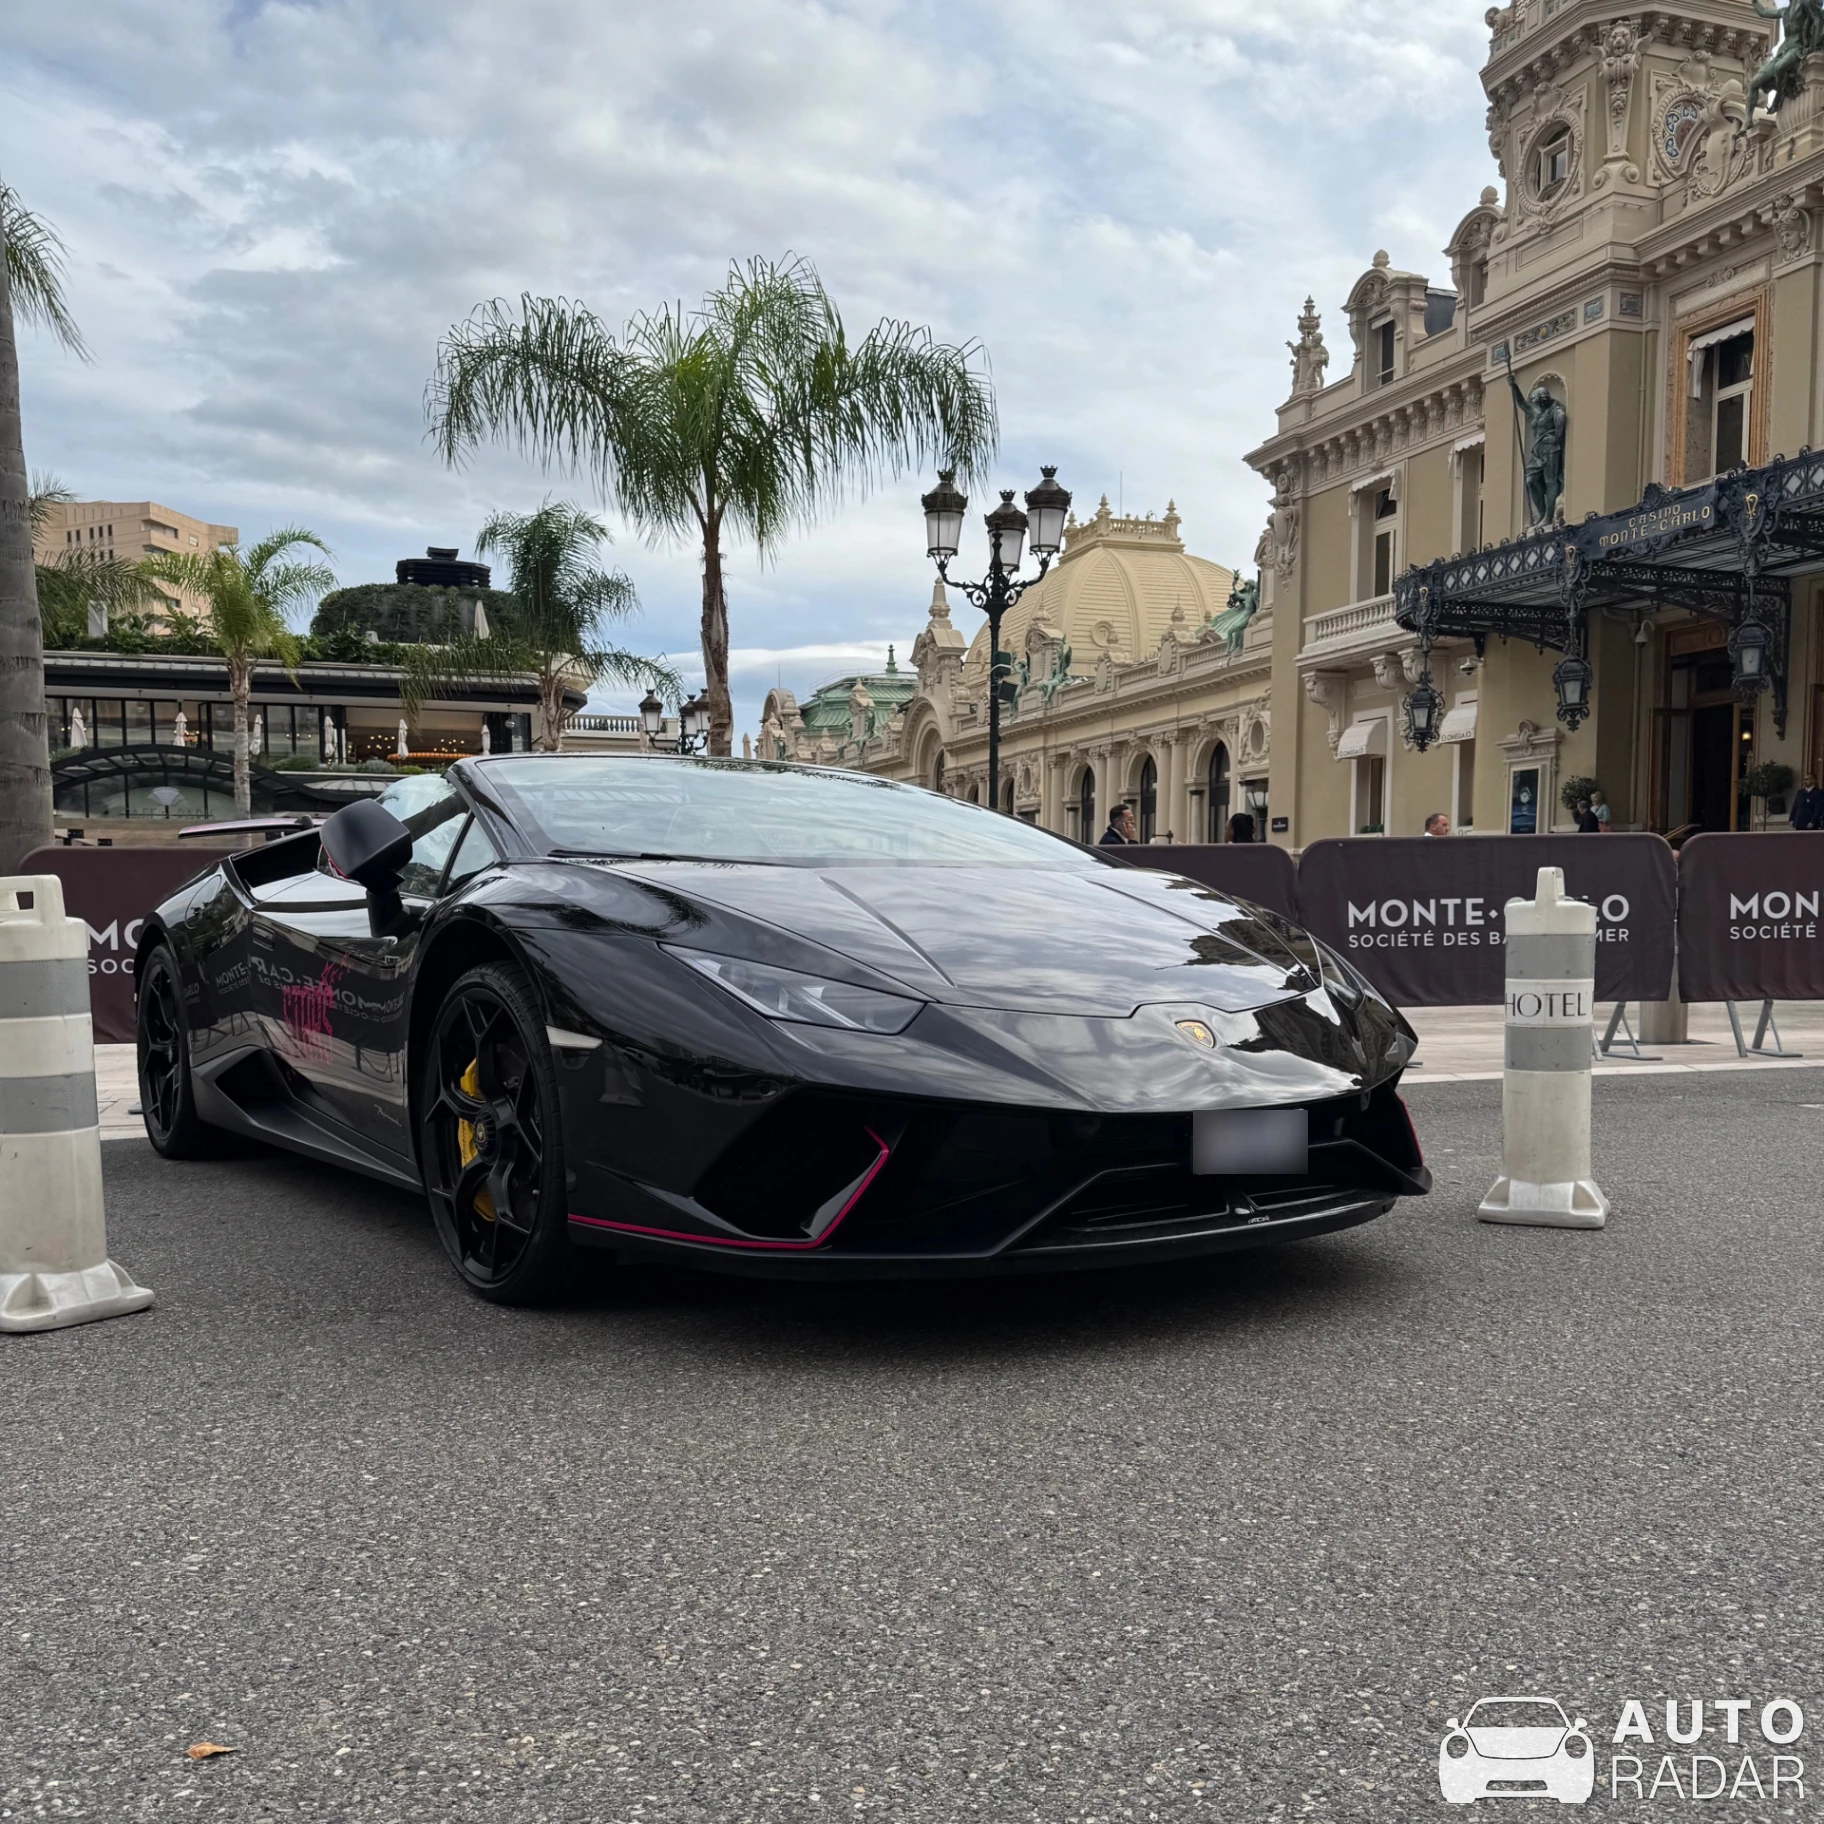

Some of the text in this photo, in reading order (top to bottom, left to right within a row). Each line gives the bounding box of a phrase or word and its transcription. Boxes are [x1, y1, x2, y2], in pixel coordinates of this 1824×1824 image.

[1599, 506, 1710, 547] MONTE-CARLO
[1628, 504, 1681, 528] CASINO
[1349, 930, 1434, 948] SOCIÉTÉ
[1443, 932, 1480, 946] DES
[1730, 921, 1817, 940] SOCIÉTÉ
[1505, 992, 1587, 1018] HOTEL
